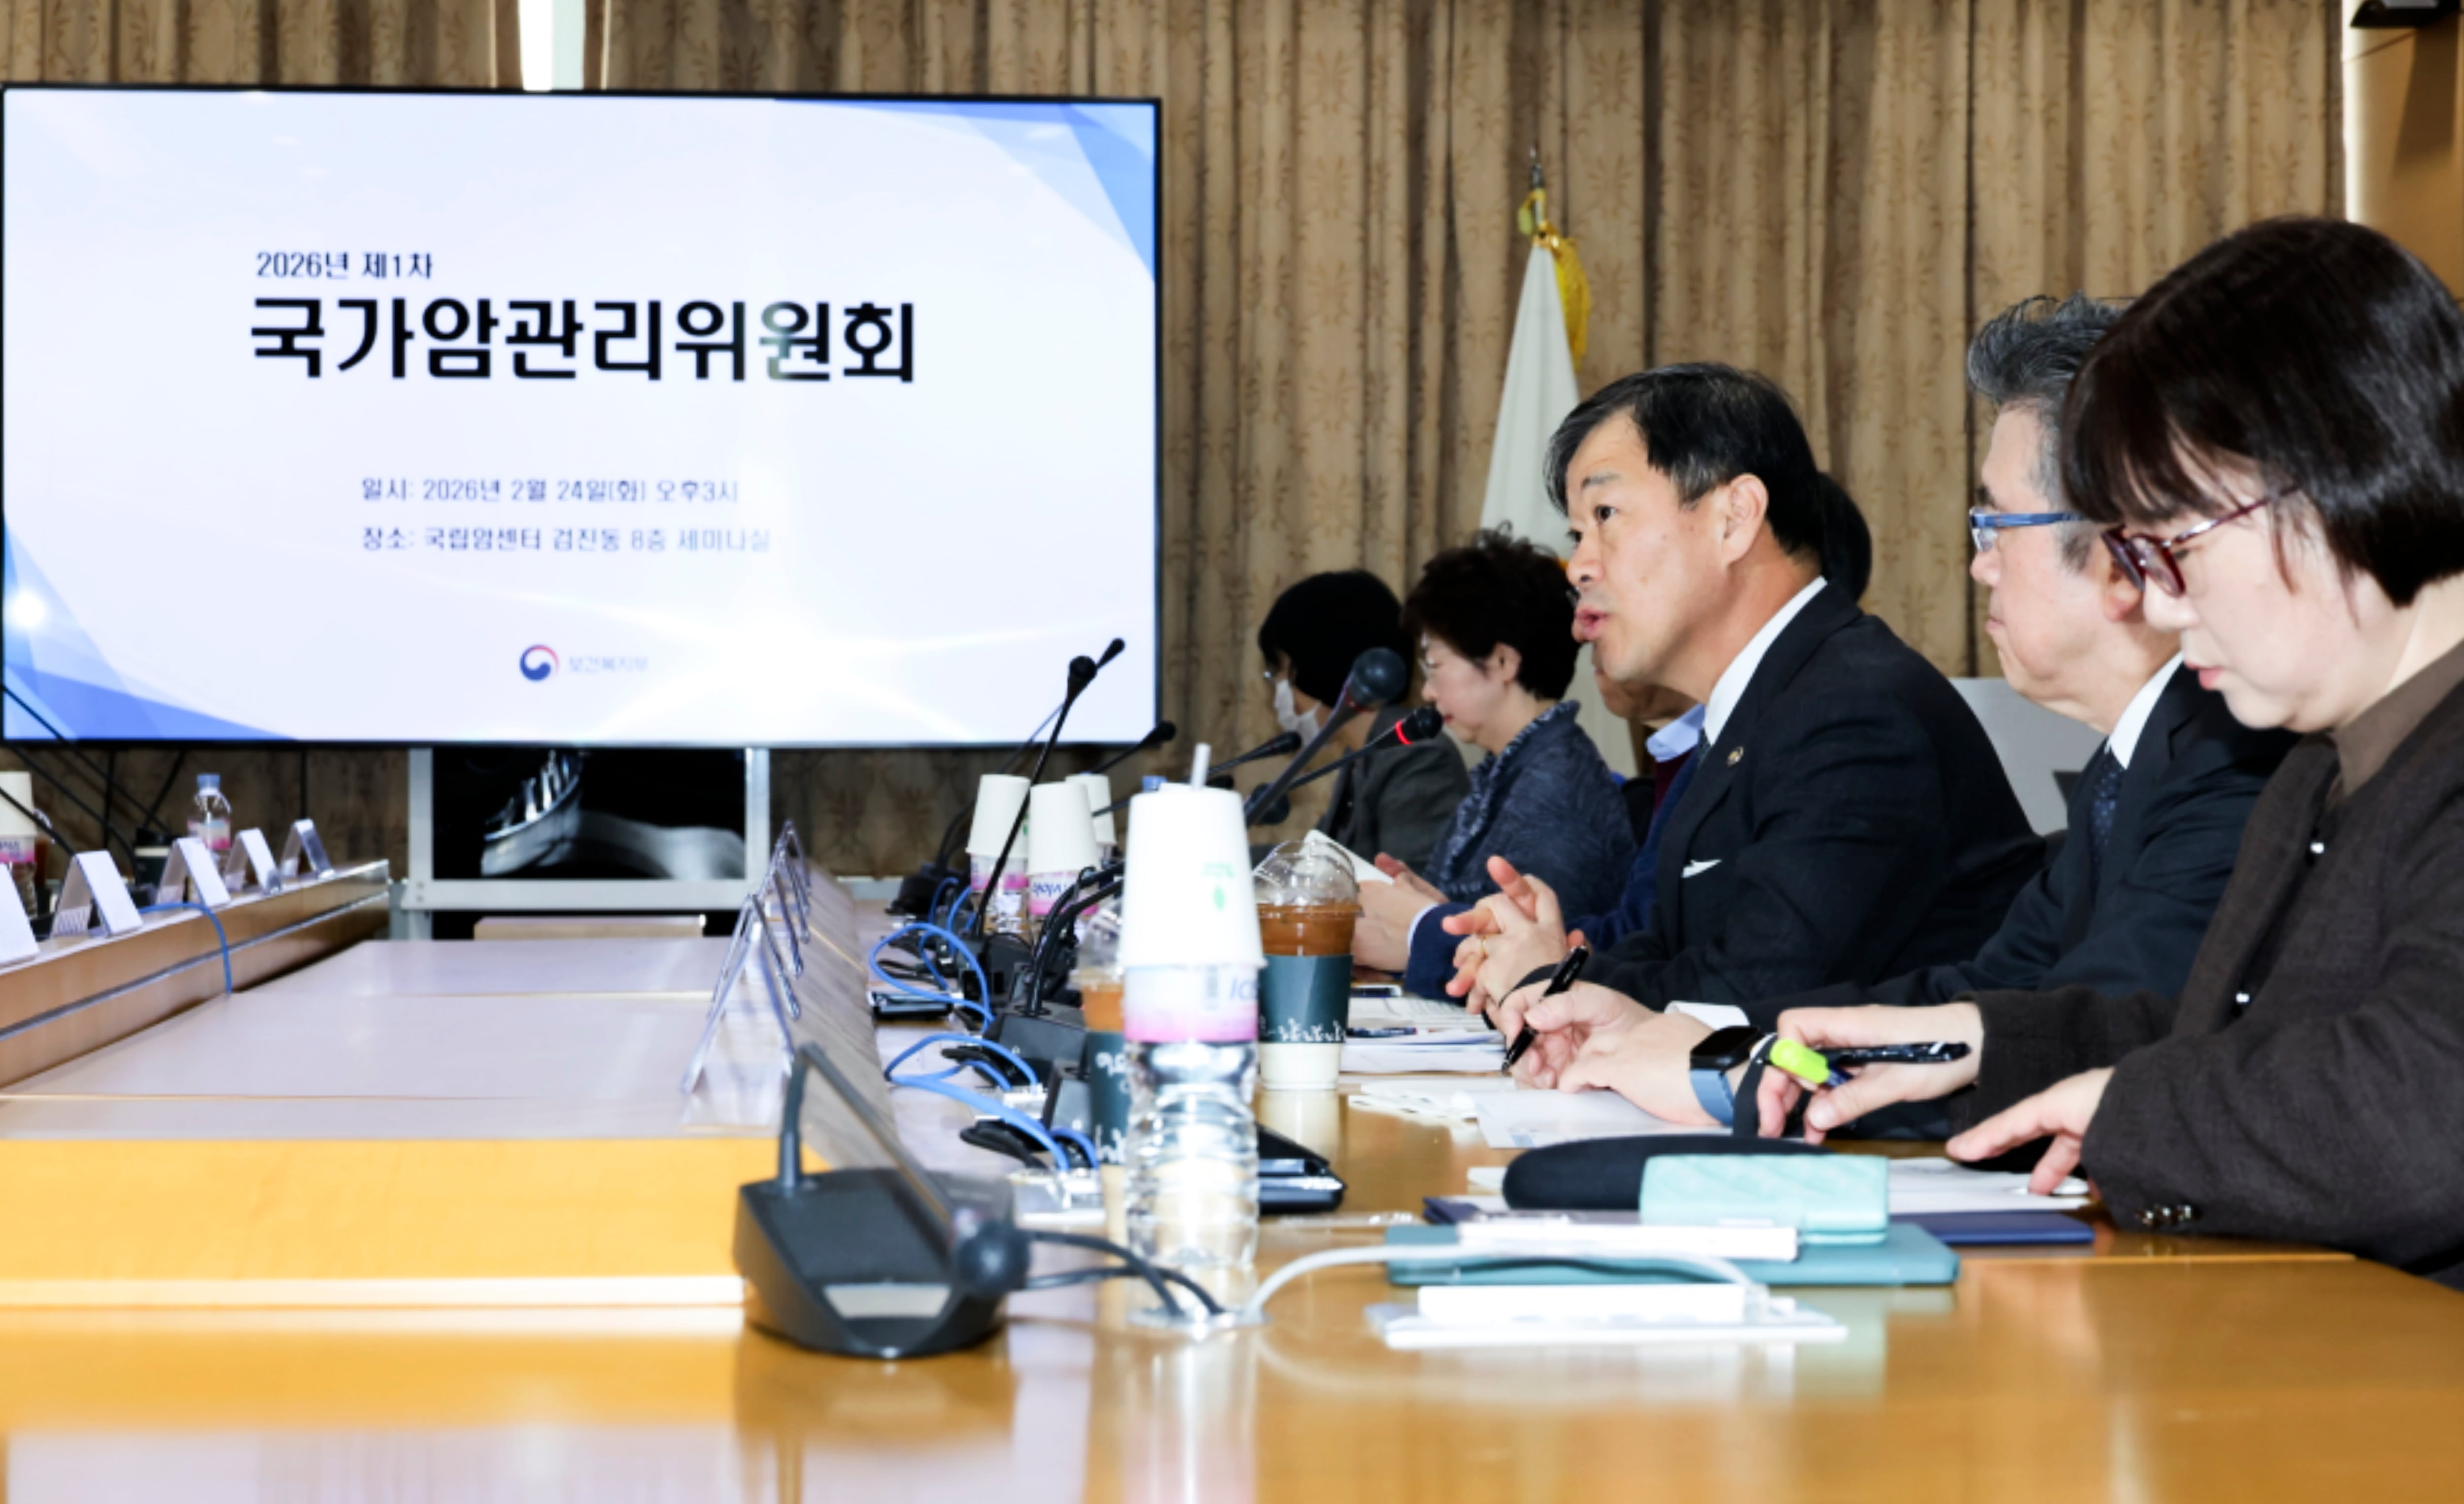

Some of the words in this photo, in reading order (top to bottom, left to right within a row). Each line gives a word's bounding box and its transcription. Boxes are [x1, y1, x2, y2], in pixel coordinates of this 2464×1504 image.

[255, 250, 349, 280] 2026년
[361, 250, 434, 280] 제1차
[250, 296, 914, 384] 국가암관리위원회
[361, 476, 414, 502] 일시:
[422, 477, 502, 503] 2026년
[511, 477, 548, 503] 2월
[556, 478, 647, 503] 24일(화)
[656, 479, 738, 503] 오후3시
[361, 525, 414, 552] 장소:
[424, 526, 542, 553] 국립암센터
[552, 527, 621, 553] 검진동
[630, 528, 666, 553] 8층
[677, 528, 770, 553] 세미나실
[567, 654, 649, 675] 보건복지부
